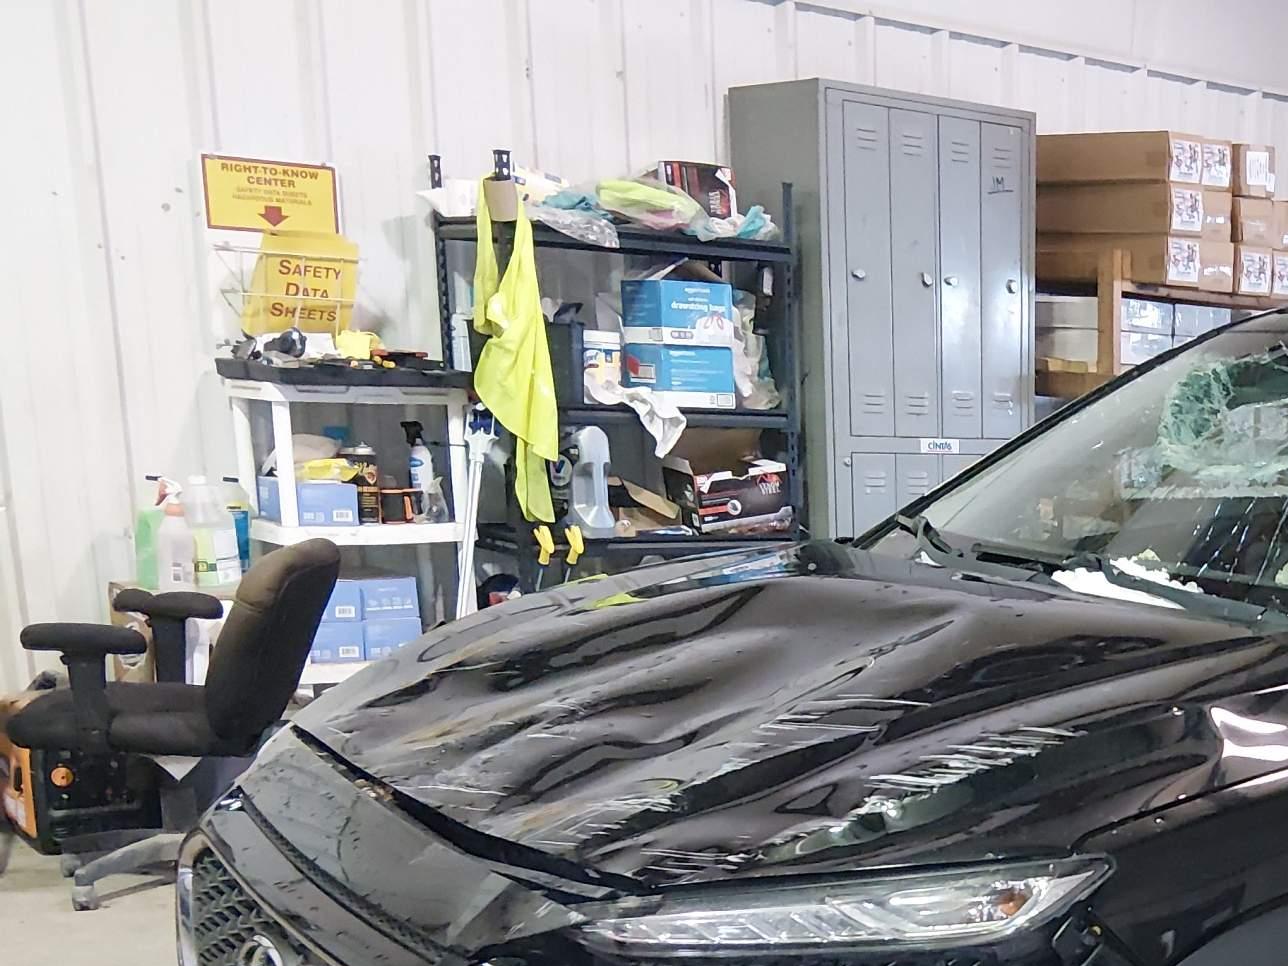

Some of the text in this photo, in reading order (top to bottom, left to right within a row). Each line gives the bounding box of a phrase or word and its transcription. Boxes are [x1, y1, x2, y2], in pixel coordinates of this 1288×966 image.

[221, 162, 319, 180] RIGHT-TO-KNOW
[247, 176, 296, 188] CENTER
[278, 259, 342, 281] SAFETY
[284, 282, 330, 299] DATA
[270, 302, 337, 323] SHEETS
